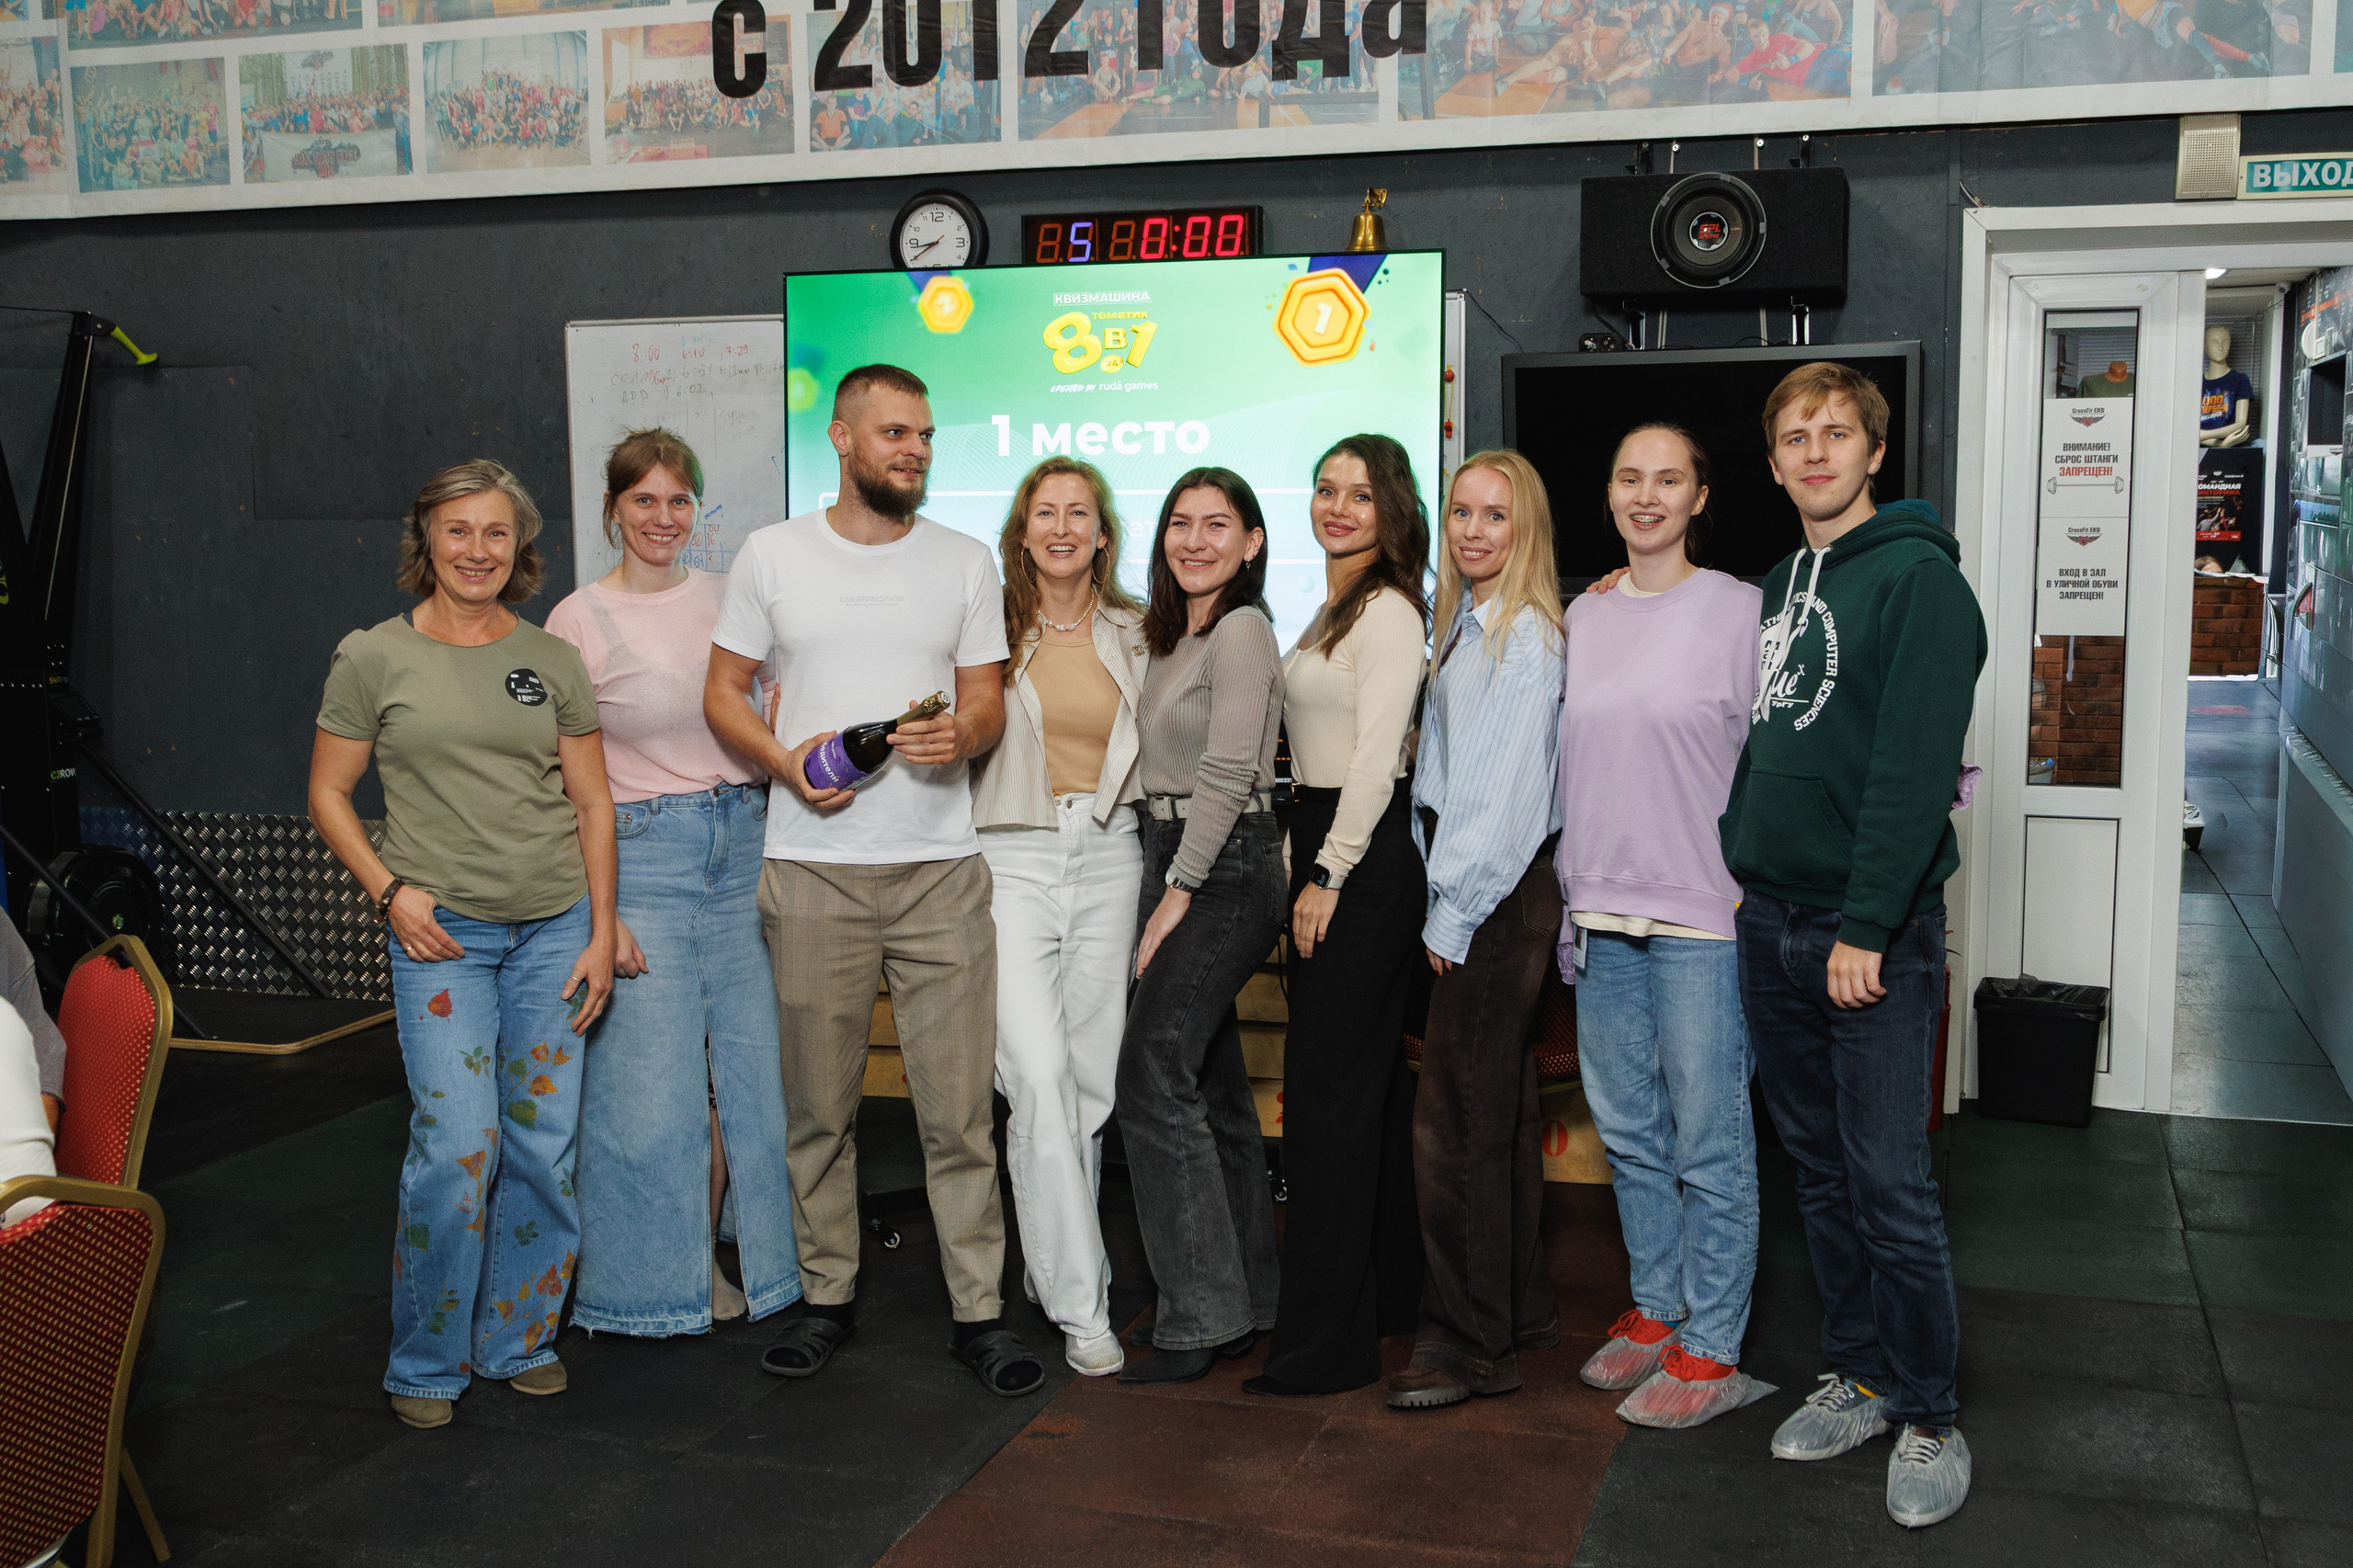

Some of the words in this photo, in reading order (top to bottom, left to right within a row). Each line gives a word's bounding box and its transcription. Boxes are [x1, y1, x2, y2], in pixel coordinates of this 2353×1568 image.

[813, 0, 1088, 92] 2012
[929, 211, 944, 222] 12
[955, 237, 966, 248] 3
[1140, 214, 1245, 260] 0:00
[909, 238, 919, 248] 9
[1054, 290, 1151, 304] КВИЗМАШИНА
[1091, 311, 1149, 320] тематик
[1314, 302, 1333, 335] 1
[1043, 312, 1103, 374] 8
[1125, 320, 1158, 369] 1
[1124, 381, 1159, 392] games
[992, 415, 1010, 457] 1
[1032, 420, 1211, 456] место
[2063, 443, 2110, 451] ВНИМАНИЕ!
[2055, 455, 2082, 464] СБРОС
[2084, 454, 2119, 463] ШТАНГИ
[2059, 466, 2113, 478] ЗАПРЕЩЕН!
[2059, 569, 2080, 578] ВХОД
[2082, 569, 2087, 577] В
[2089, 569, 2106, 577] ЗАЛ
[2054, 578, 2089, 588] УЛИЧНОЙ
[2092, 580, 2118, 588] ОБУВИ
[2059, 591, 2104, 601] ЗАПРЕЩЕН!
[1822, 611, 1838, 677] COMPUTER
[1793, 678, 1836, 731] SCIENCES
